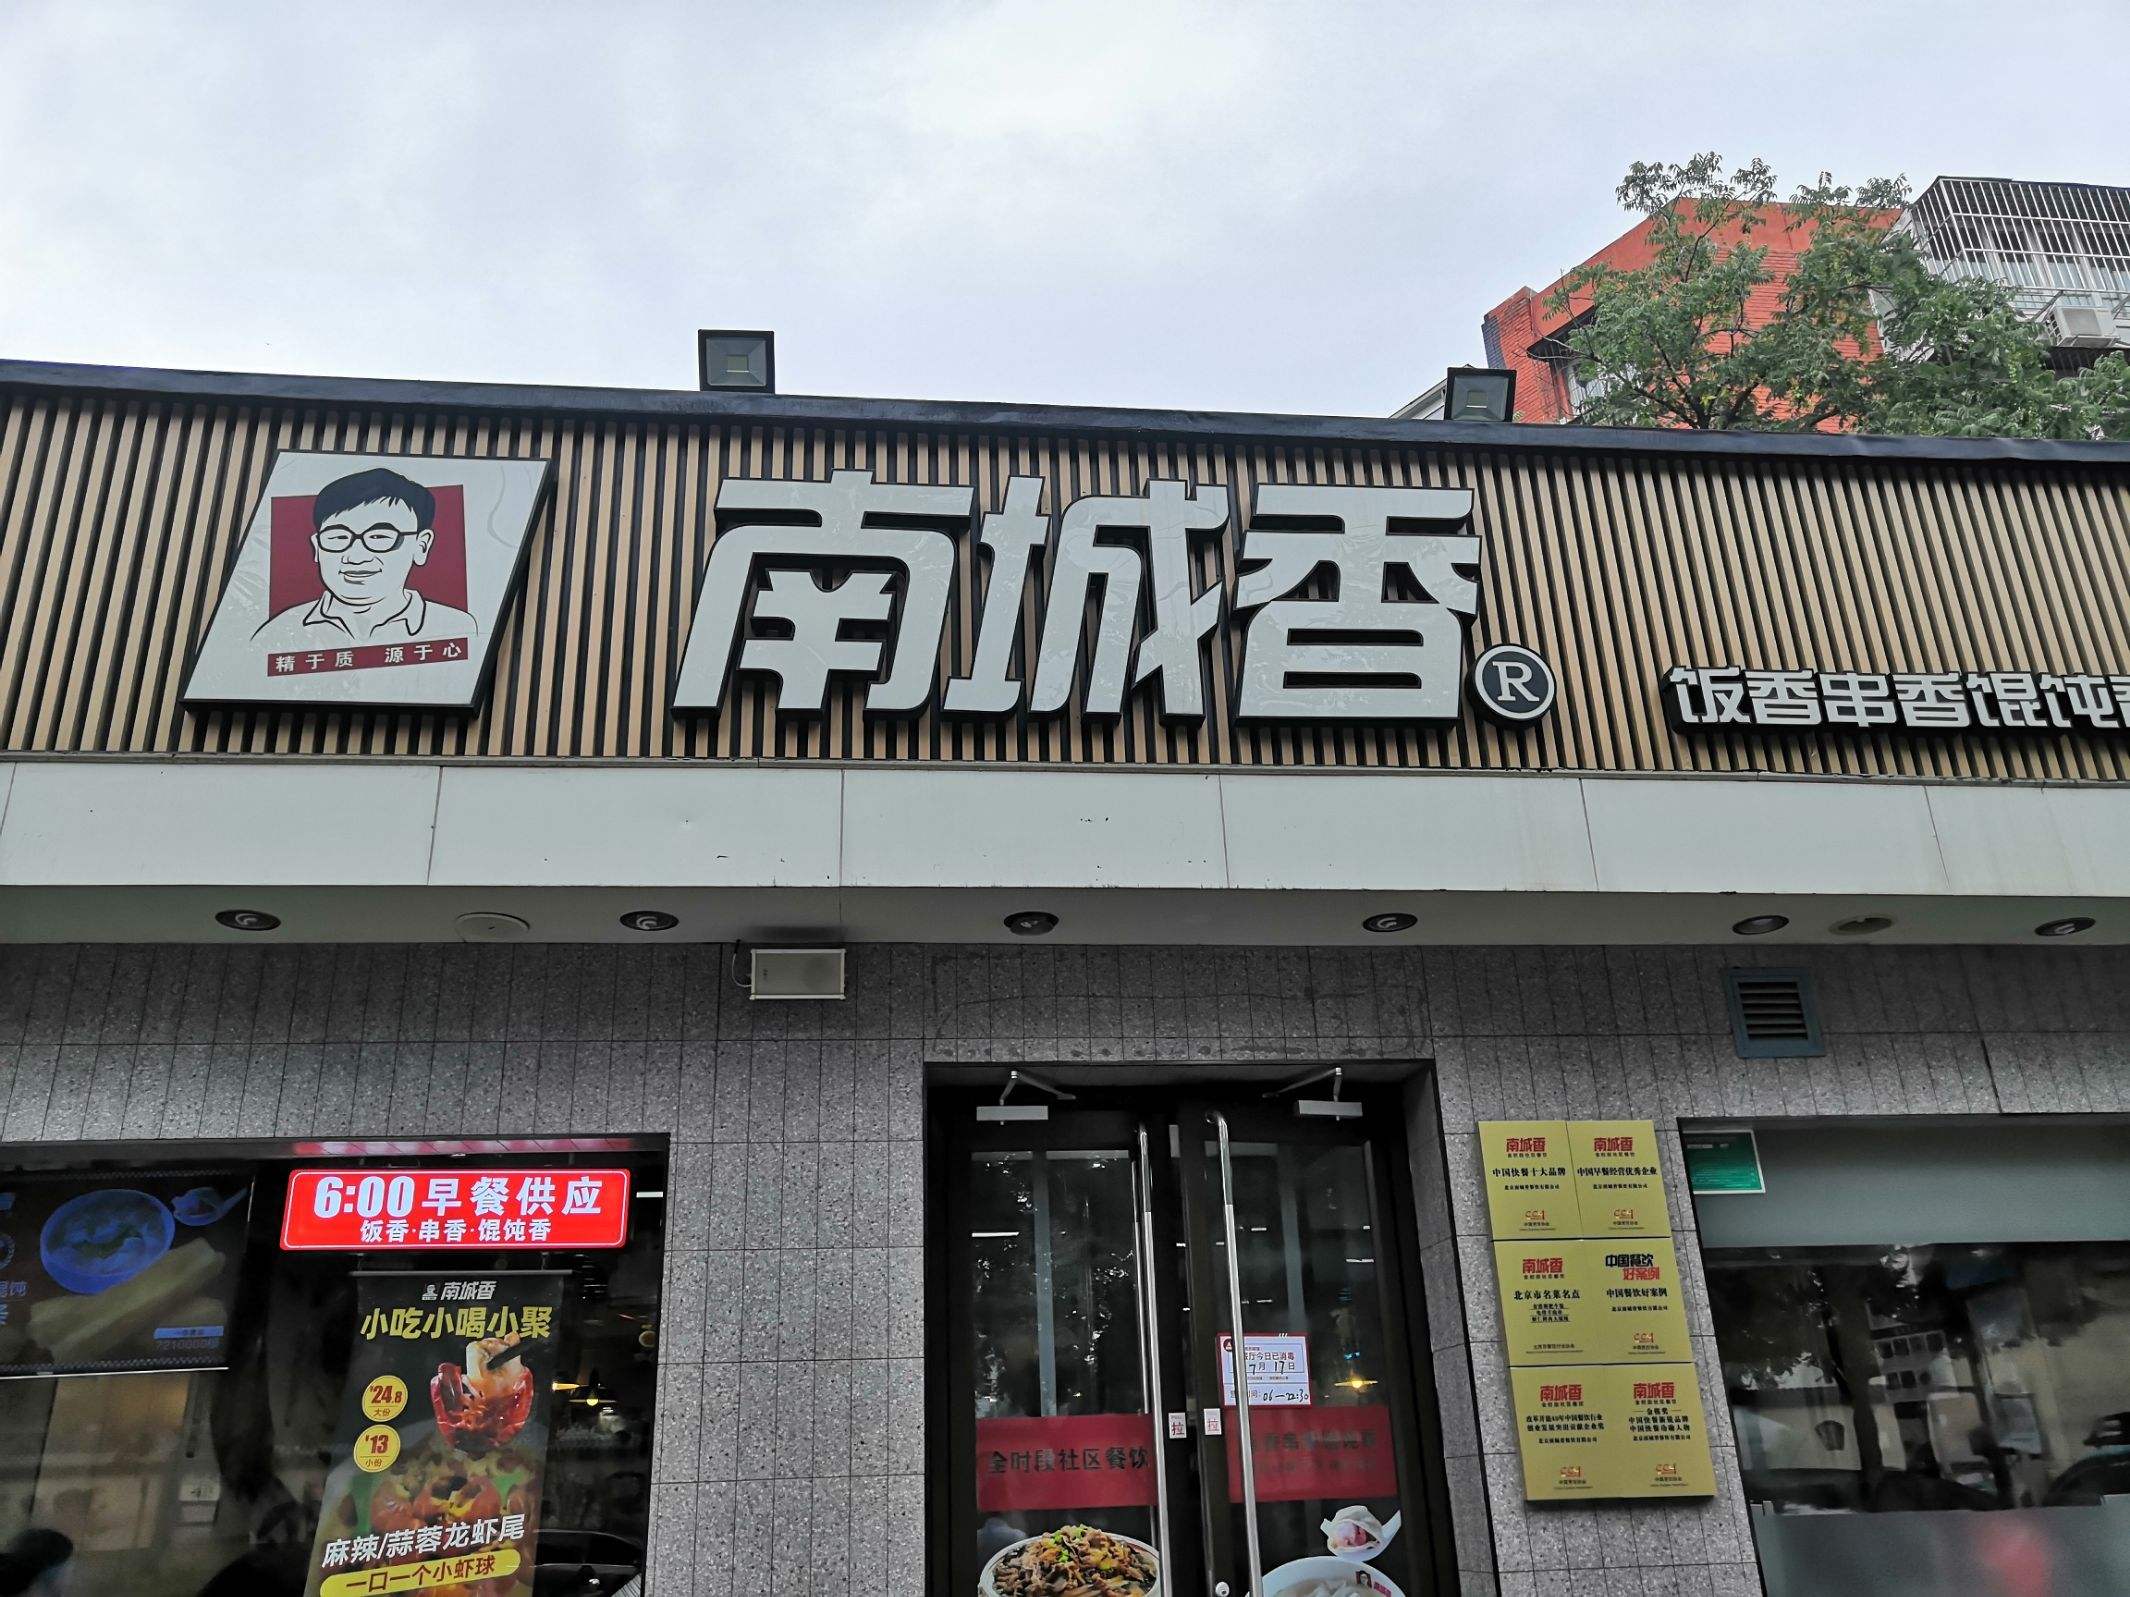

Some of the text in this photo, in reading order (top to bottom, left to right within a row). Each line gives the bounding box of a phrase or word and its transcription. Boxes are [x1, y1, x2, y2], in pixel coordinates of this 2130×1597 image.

[671, 470, 1481, 718] 南城香
[275, 641, 462, 672] 精于质 源于心
[1506, 1136, 1546, 1152] 南城香
[1594, 1136, 1633, 1151] 南城香
[1492, 1167, 1566, 1177] 中国快餐十大品牌
[1577, 1166, 1658, 1176] 中国早餐经营优秀企业
[1522, 1257, 1563, 1274] 南城香
[1606, 1254, 1654, 1267] 中国餐饮
[1622, 1267, 1660, 1281] 好案例
[440, 1281, 497, 1301] 南城香
[1514, 1290, 1580, 1300] 北京市名菜名点
[1606, 1288, 1668, 1298] 中国餐饮好案例
[360, 1306, 552, 1340] 小吃小喝小聚
[1540, 1384, 1582, 1401] 南城香
[1633, 1382, 1675, 1399] 南城香
[1171, 1421, 1185, 1436] 拉
[988, 1447, 1149, 1473] 全时段社区餐饮
[346, 1555, 496, 1592] 一口一个小虾球
